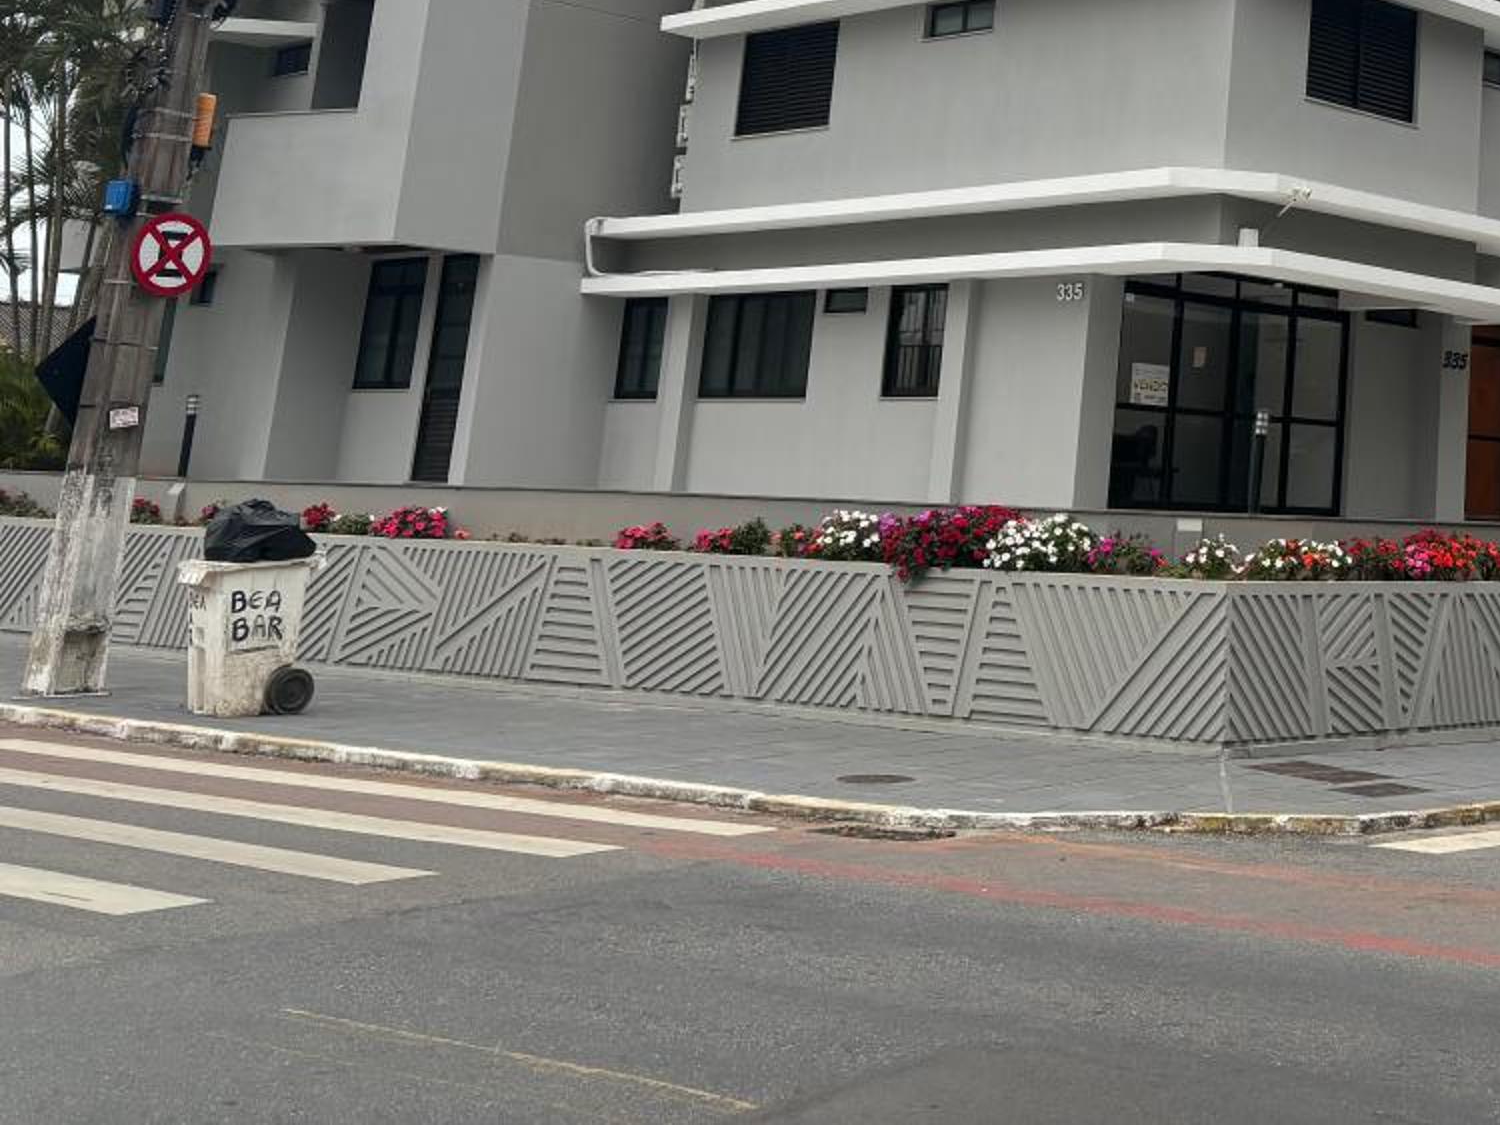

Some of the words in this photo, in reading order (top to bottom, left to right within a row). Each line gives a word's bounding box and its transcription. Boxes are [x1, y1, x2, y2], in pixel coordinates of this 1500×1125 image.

[1056, 282, 1083, 300] 335
[1442, 350, 1469, 370] 335
[231, 590, 282, 613] BEA
[232, 615, 283, 642] BAR
